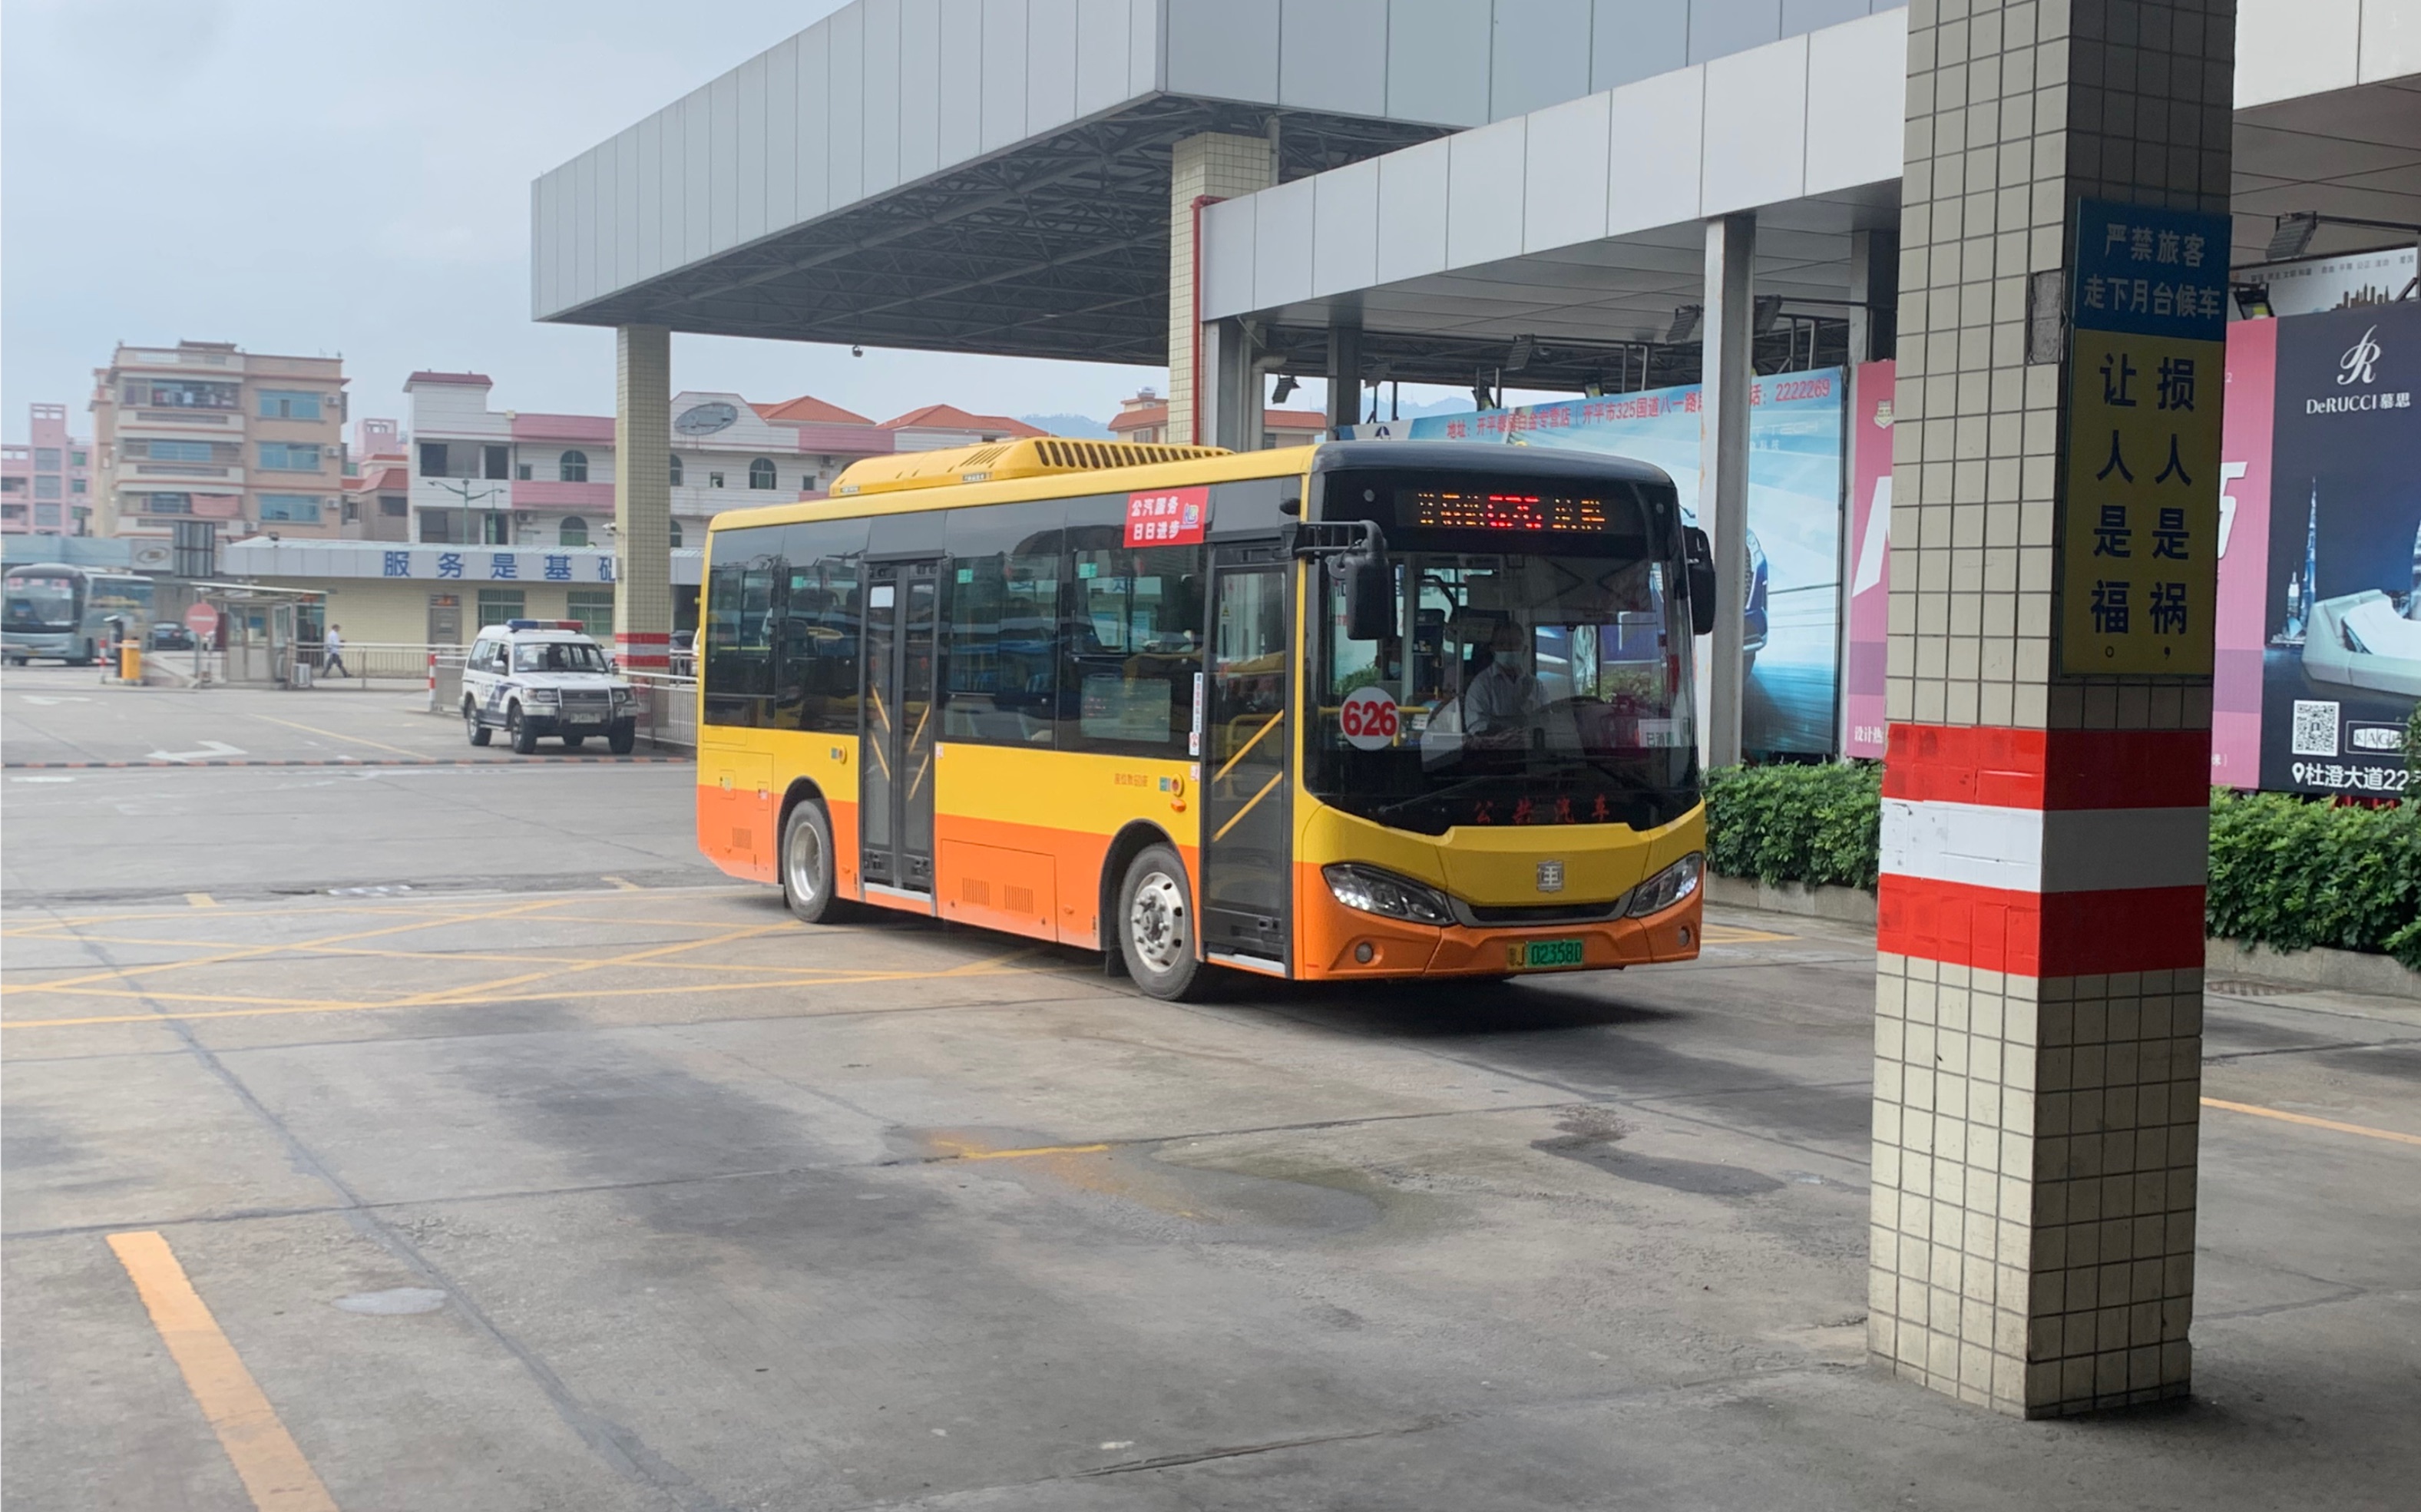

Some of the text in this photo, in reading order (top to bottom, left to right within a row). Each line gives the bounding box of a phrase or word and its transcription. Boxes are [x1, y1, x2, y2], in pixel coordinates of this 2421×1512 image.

[2105, 223, 2205, 268] 严禁旅客
[2083, 273, 2221, 320] 走下月台候车
[2306, 392, 2411, 415] DeRUCCI 慕思
[1131, 496, 1179, 517] 公汽服务
[1133, 520, 1180, 541] 日日进步
[1343, 700, 1397, 736] 626
[2304, 762, 2421, 791] 杜澄大道22
